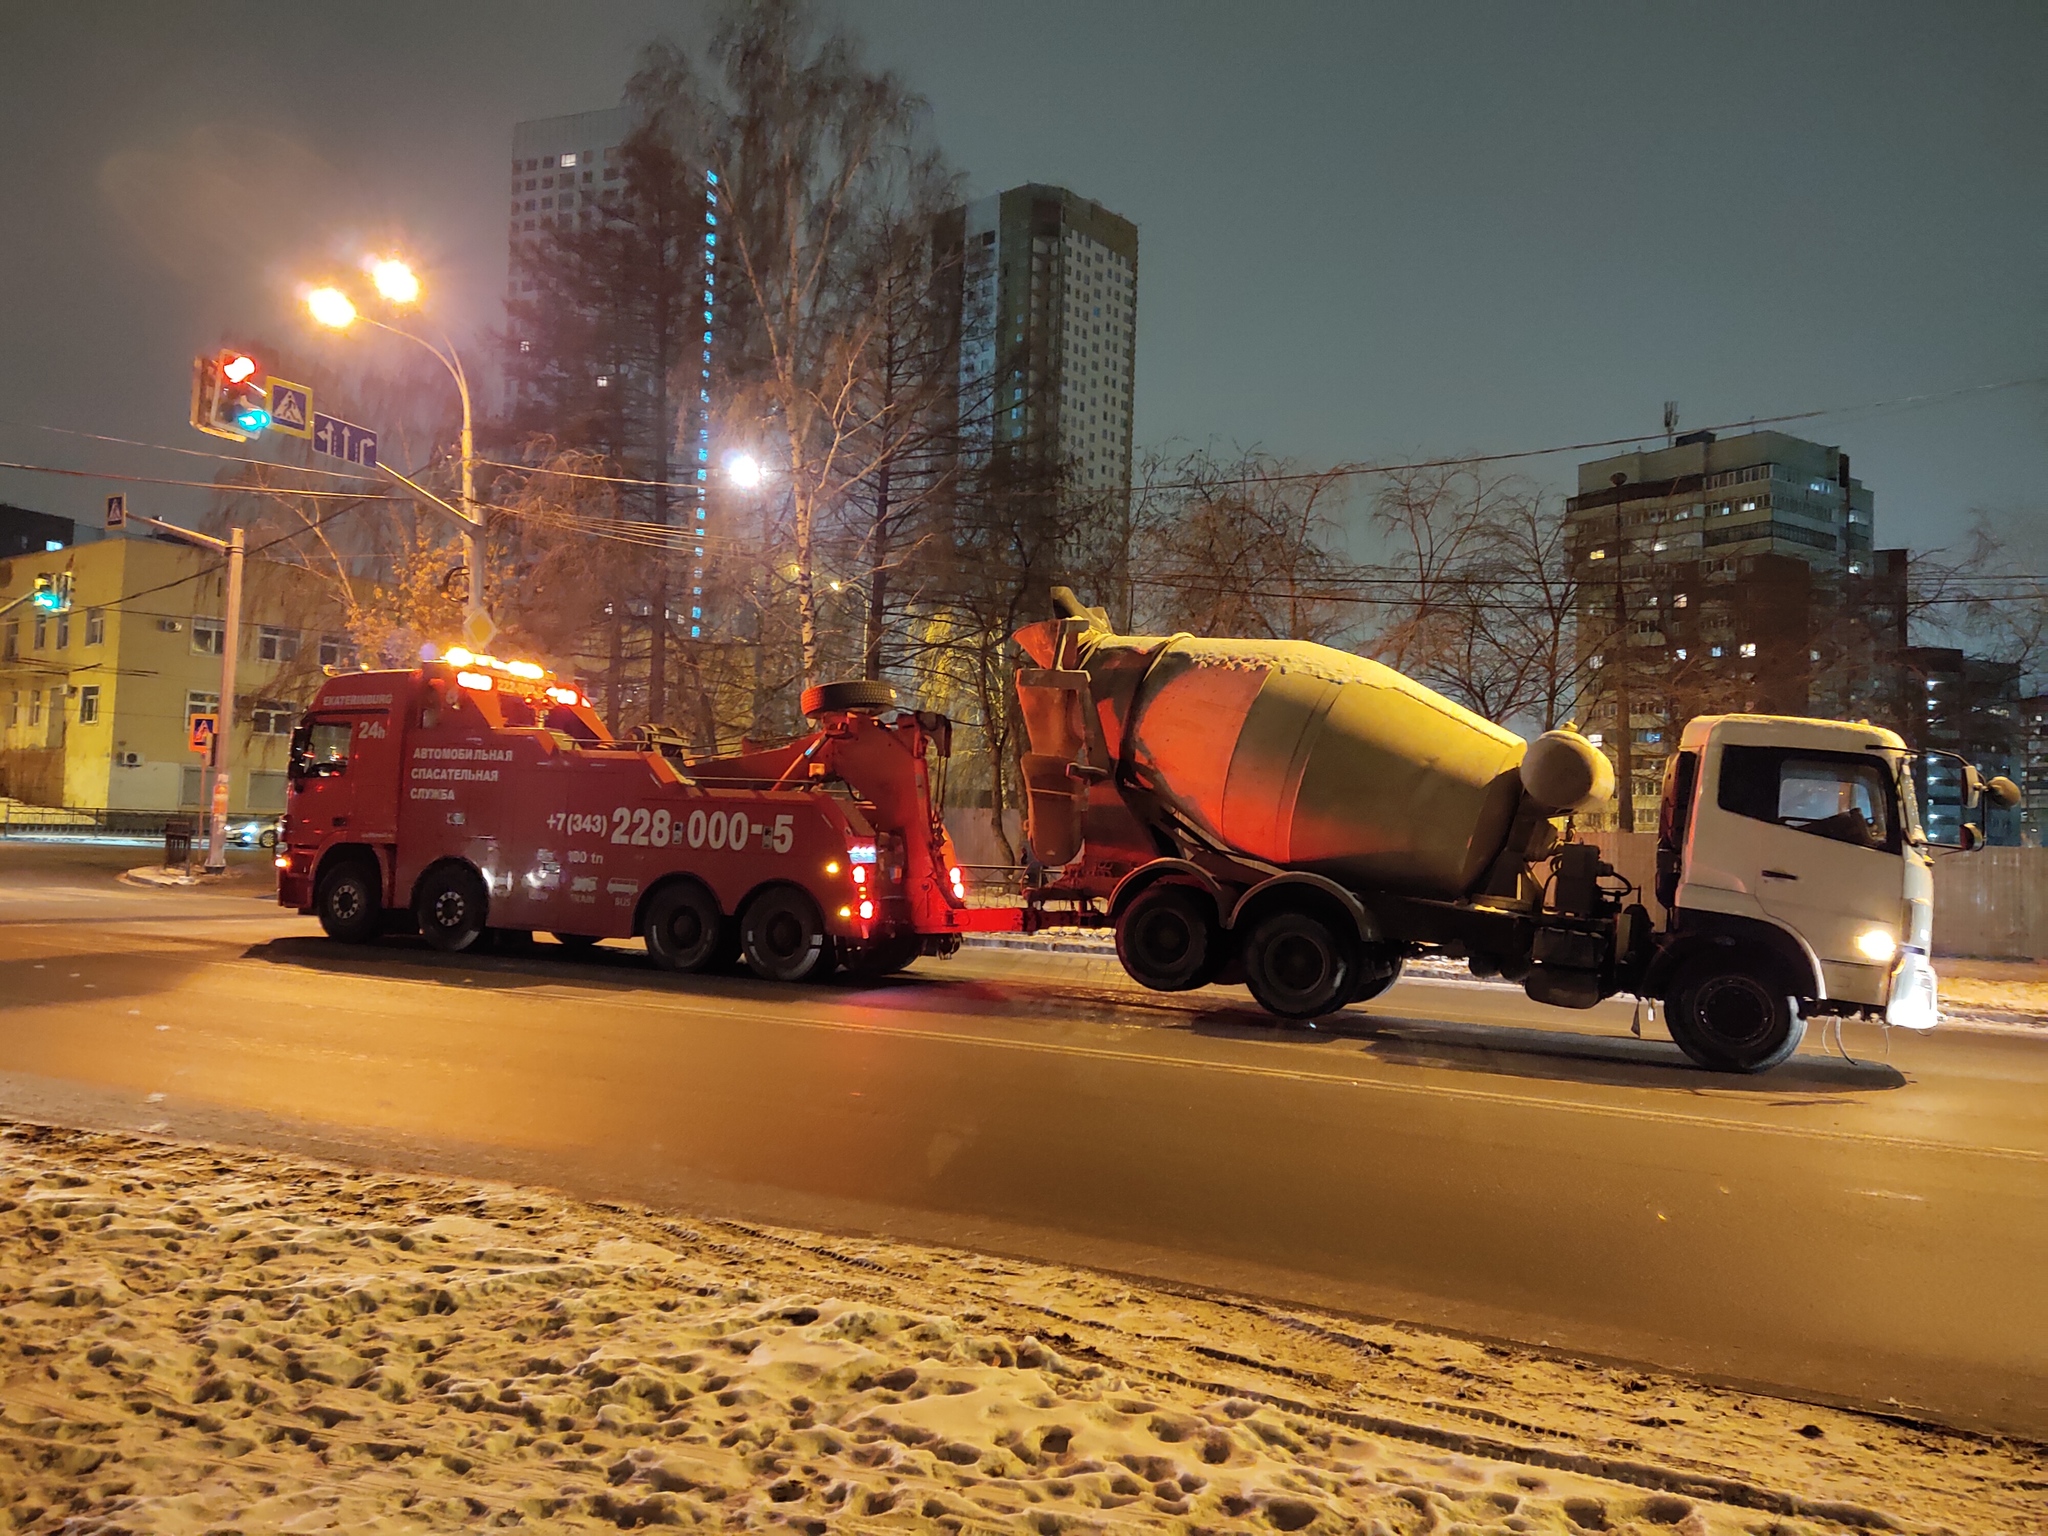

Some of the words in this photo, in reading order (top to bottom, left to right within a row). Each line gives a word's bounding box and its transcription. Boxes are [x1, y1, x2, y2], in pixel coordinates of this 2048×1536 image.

[358, 721, 386, 739] 24h
[413, 747, 513, 761] АВТОМОБИЛЬНАЯ
[411, 768, 499, 781] СПАСАТЕЛЬНАЯ
[410, 788, 455, 800] СЛУЖБА
[546, 813, 608, 837] +7(343)
[614, 897, 631, 907] BUS
